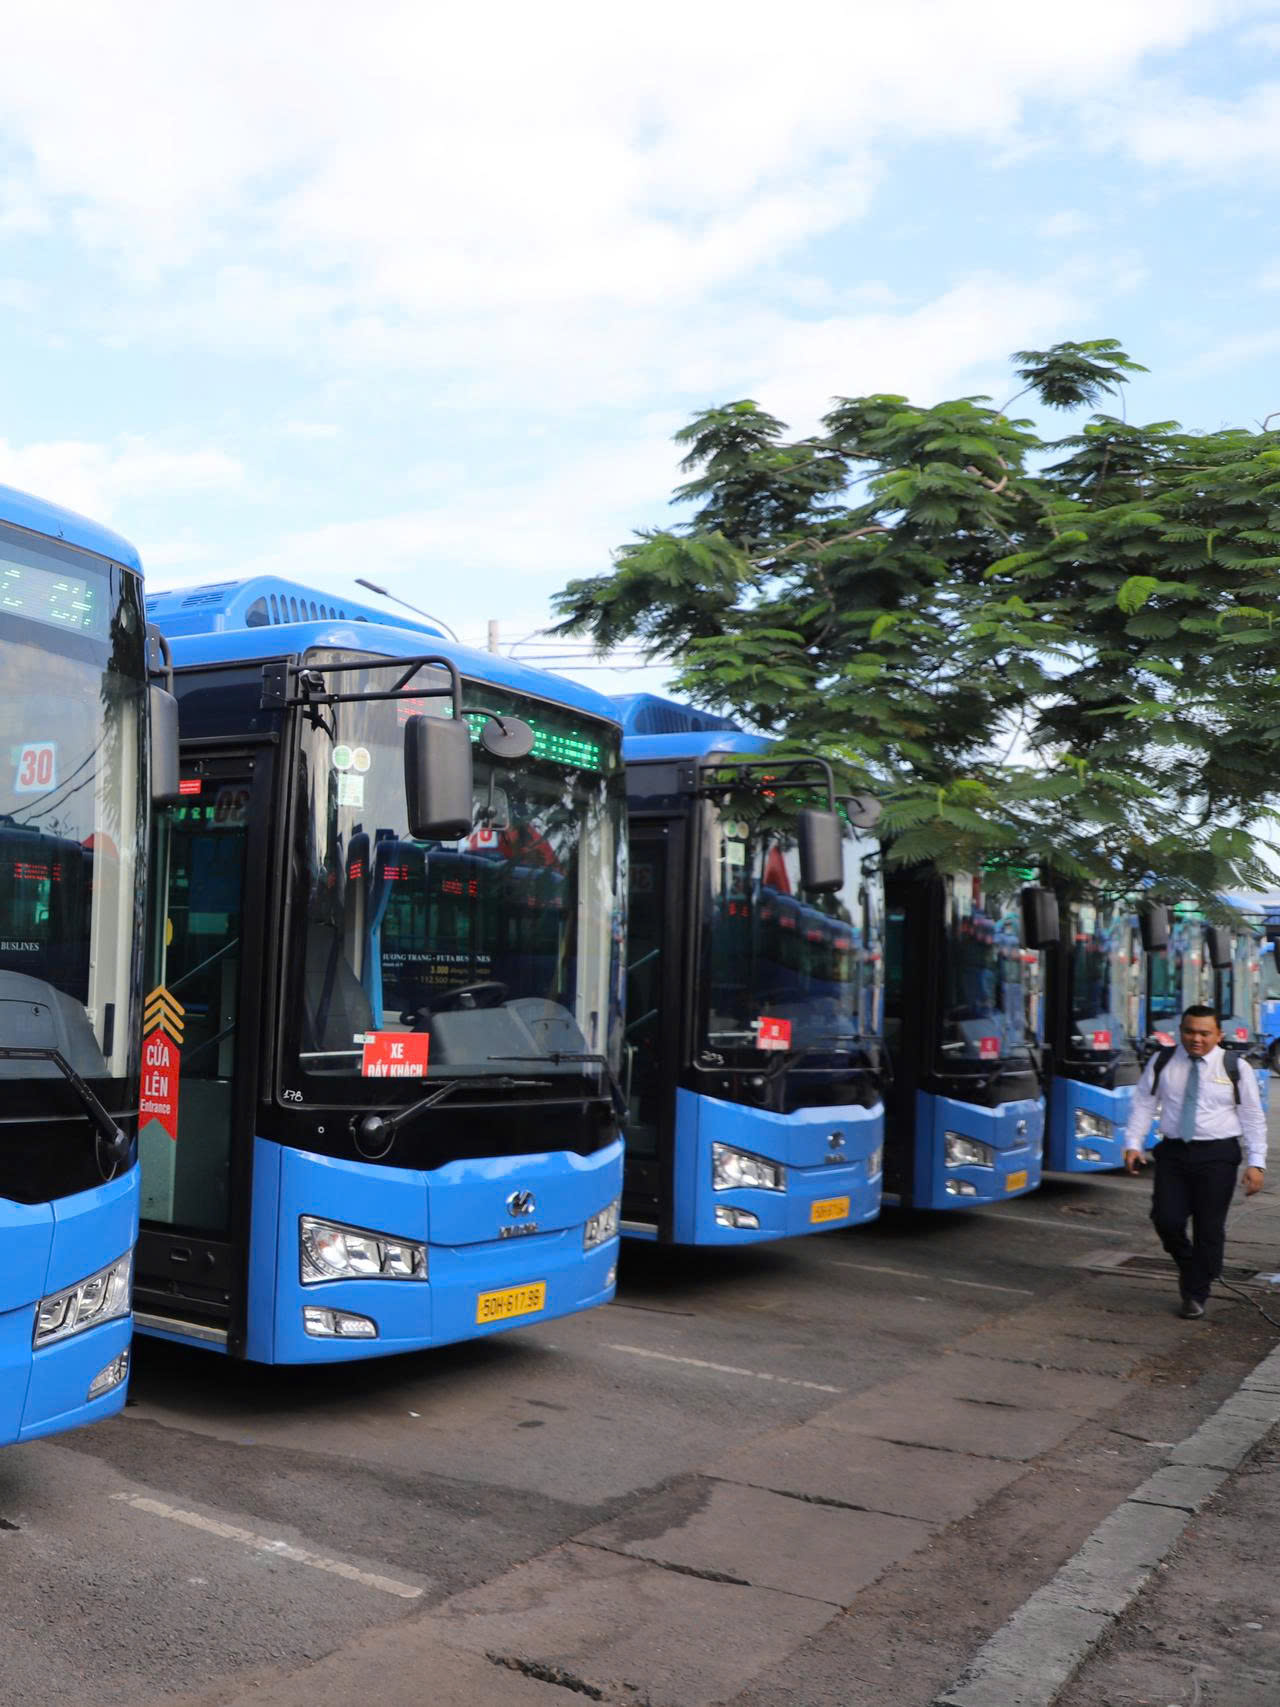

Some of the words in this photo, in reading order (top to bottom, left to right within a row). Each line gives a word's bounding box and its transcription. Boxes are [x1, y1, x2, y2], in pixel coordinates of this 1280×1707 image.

[21, 749, 53, 785] 30
[1, 941, 40, 952] BUSLINES
[146, 1039, 170, 1067] CỬA
[390, 1043, 404, 1059] XE
[390, 1059, 423, 1077] KHÁCH
[145, 1070, 168, 1097] LÊN
[283, 1089, 303, 1102] 178
[140, 1099, 171, 1115] Entrance
